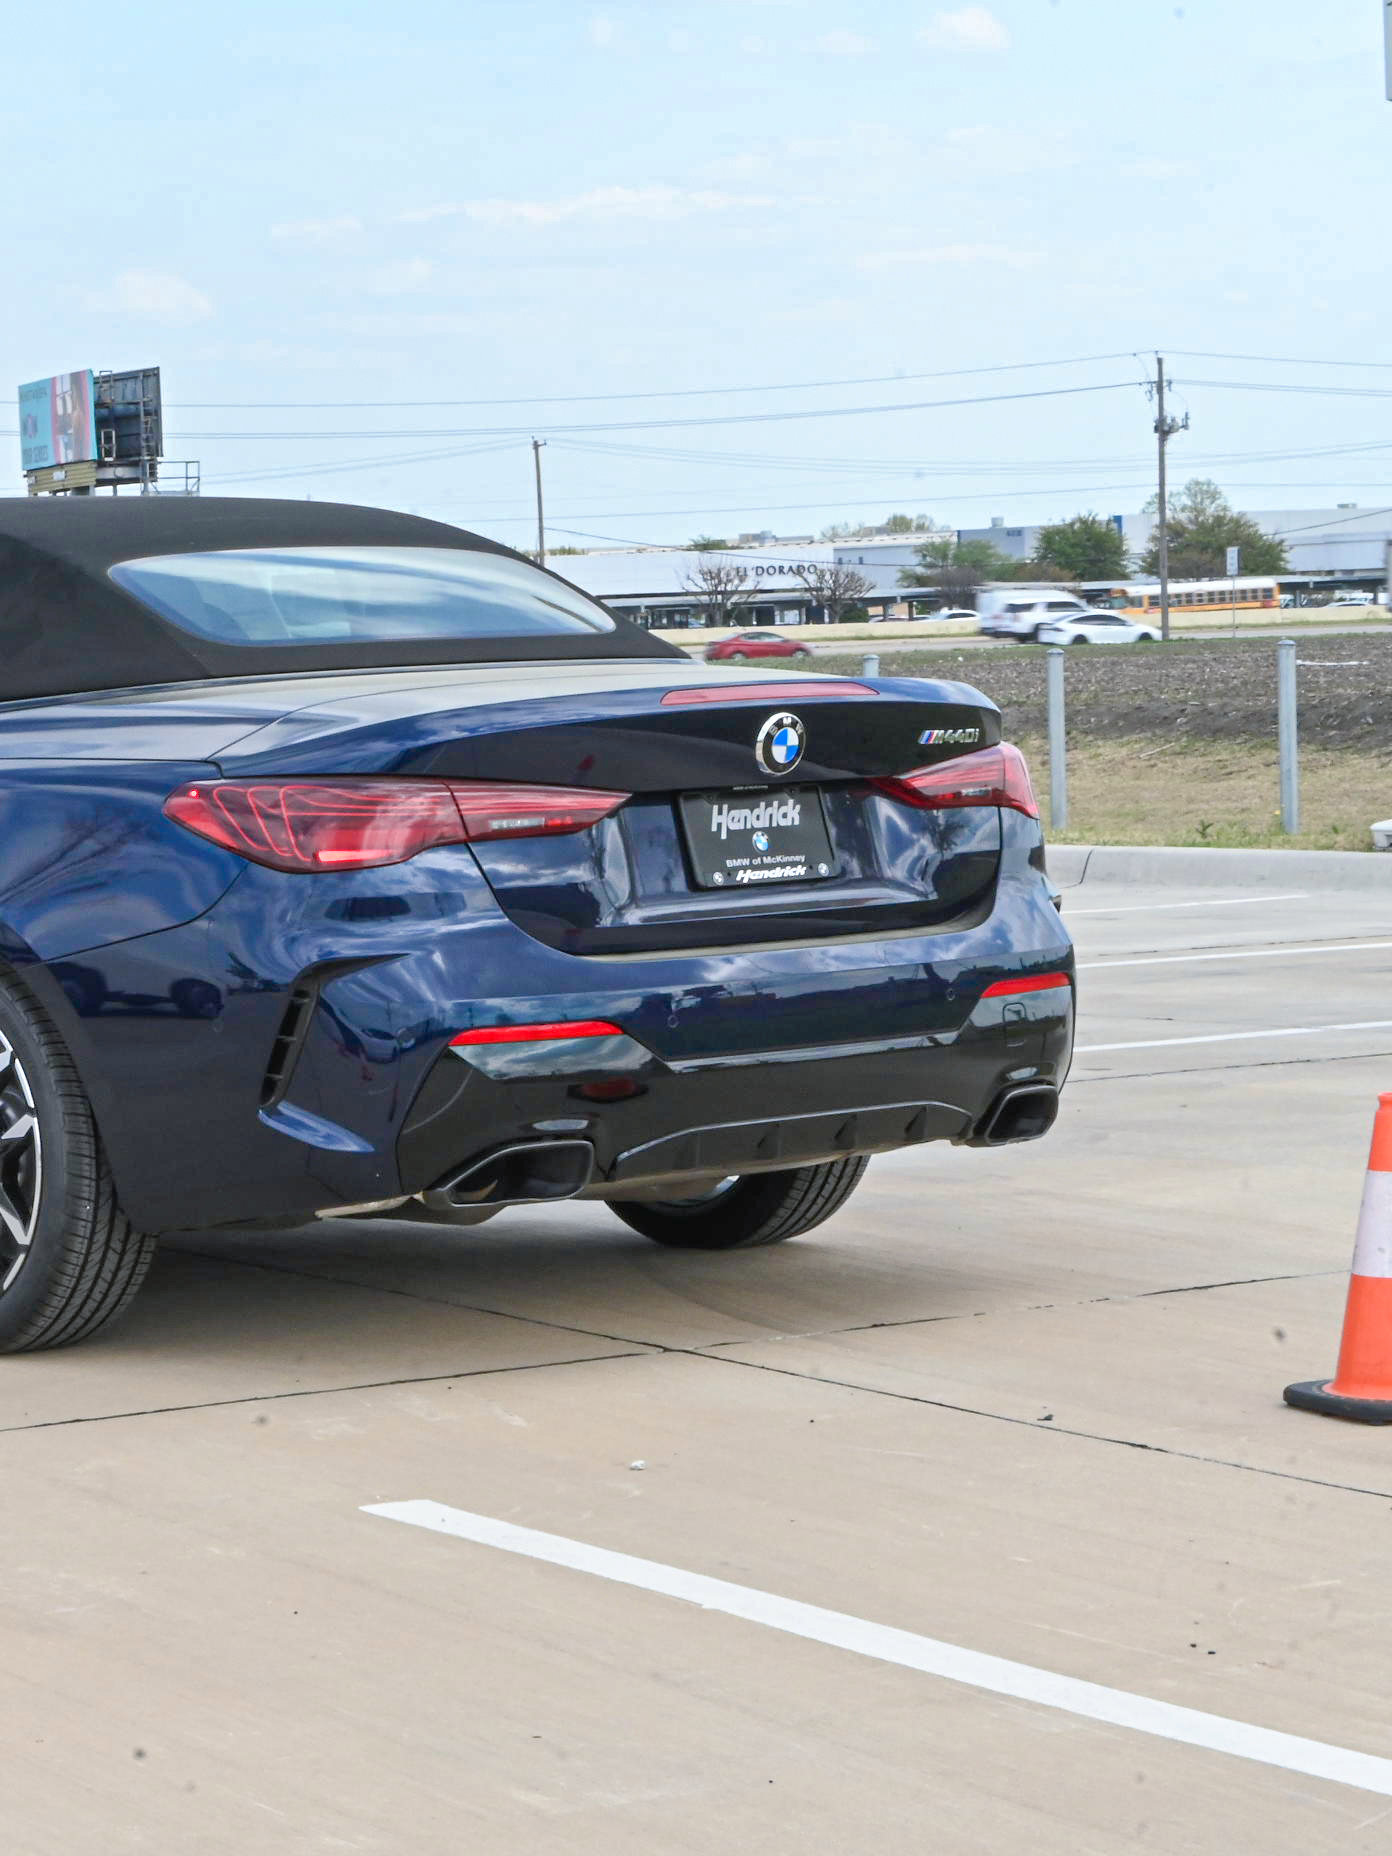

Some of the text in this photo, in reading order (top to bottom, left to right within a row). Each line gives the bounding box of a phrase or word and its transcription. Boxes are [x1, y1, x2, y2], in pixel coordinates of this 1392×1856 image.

[711, 799, 801, 840] Hendrick
[726, 854, 806, 868] BMW of McKinney
[736, 864, 807, 884] Hendrick
